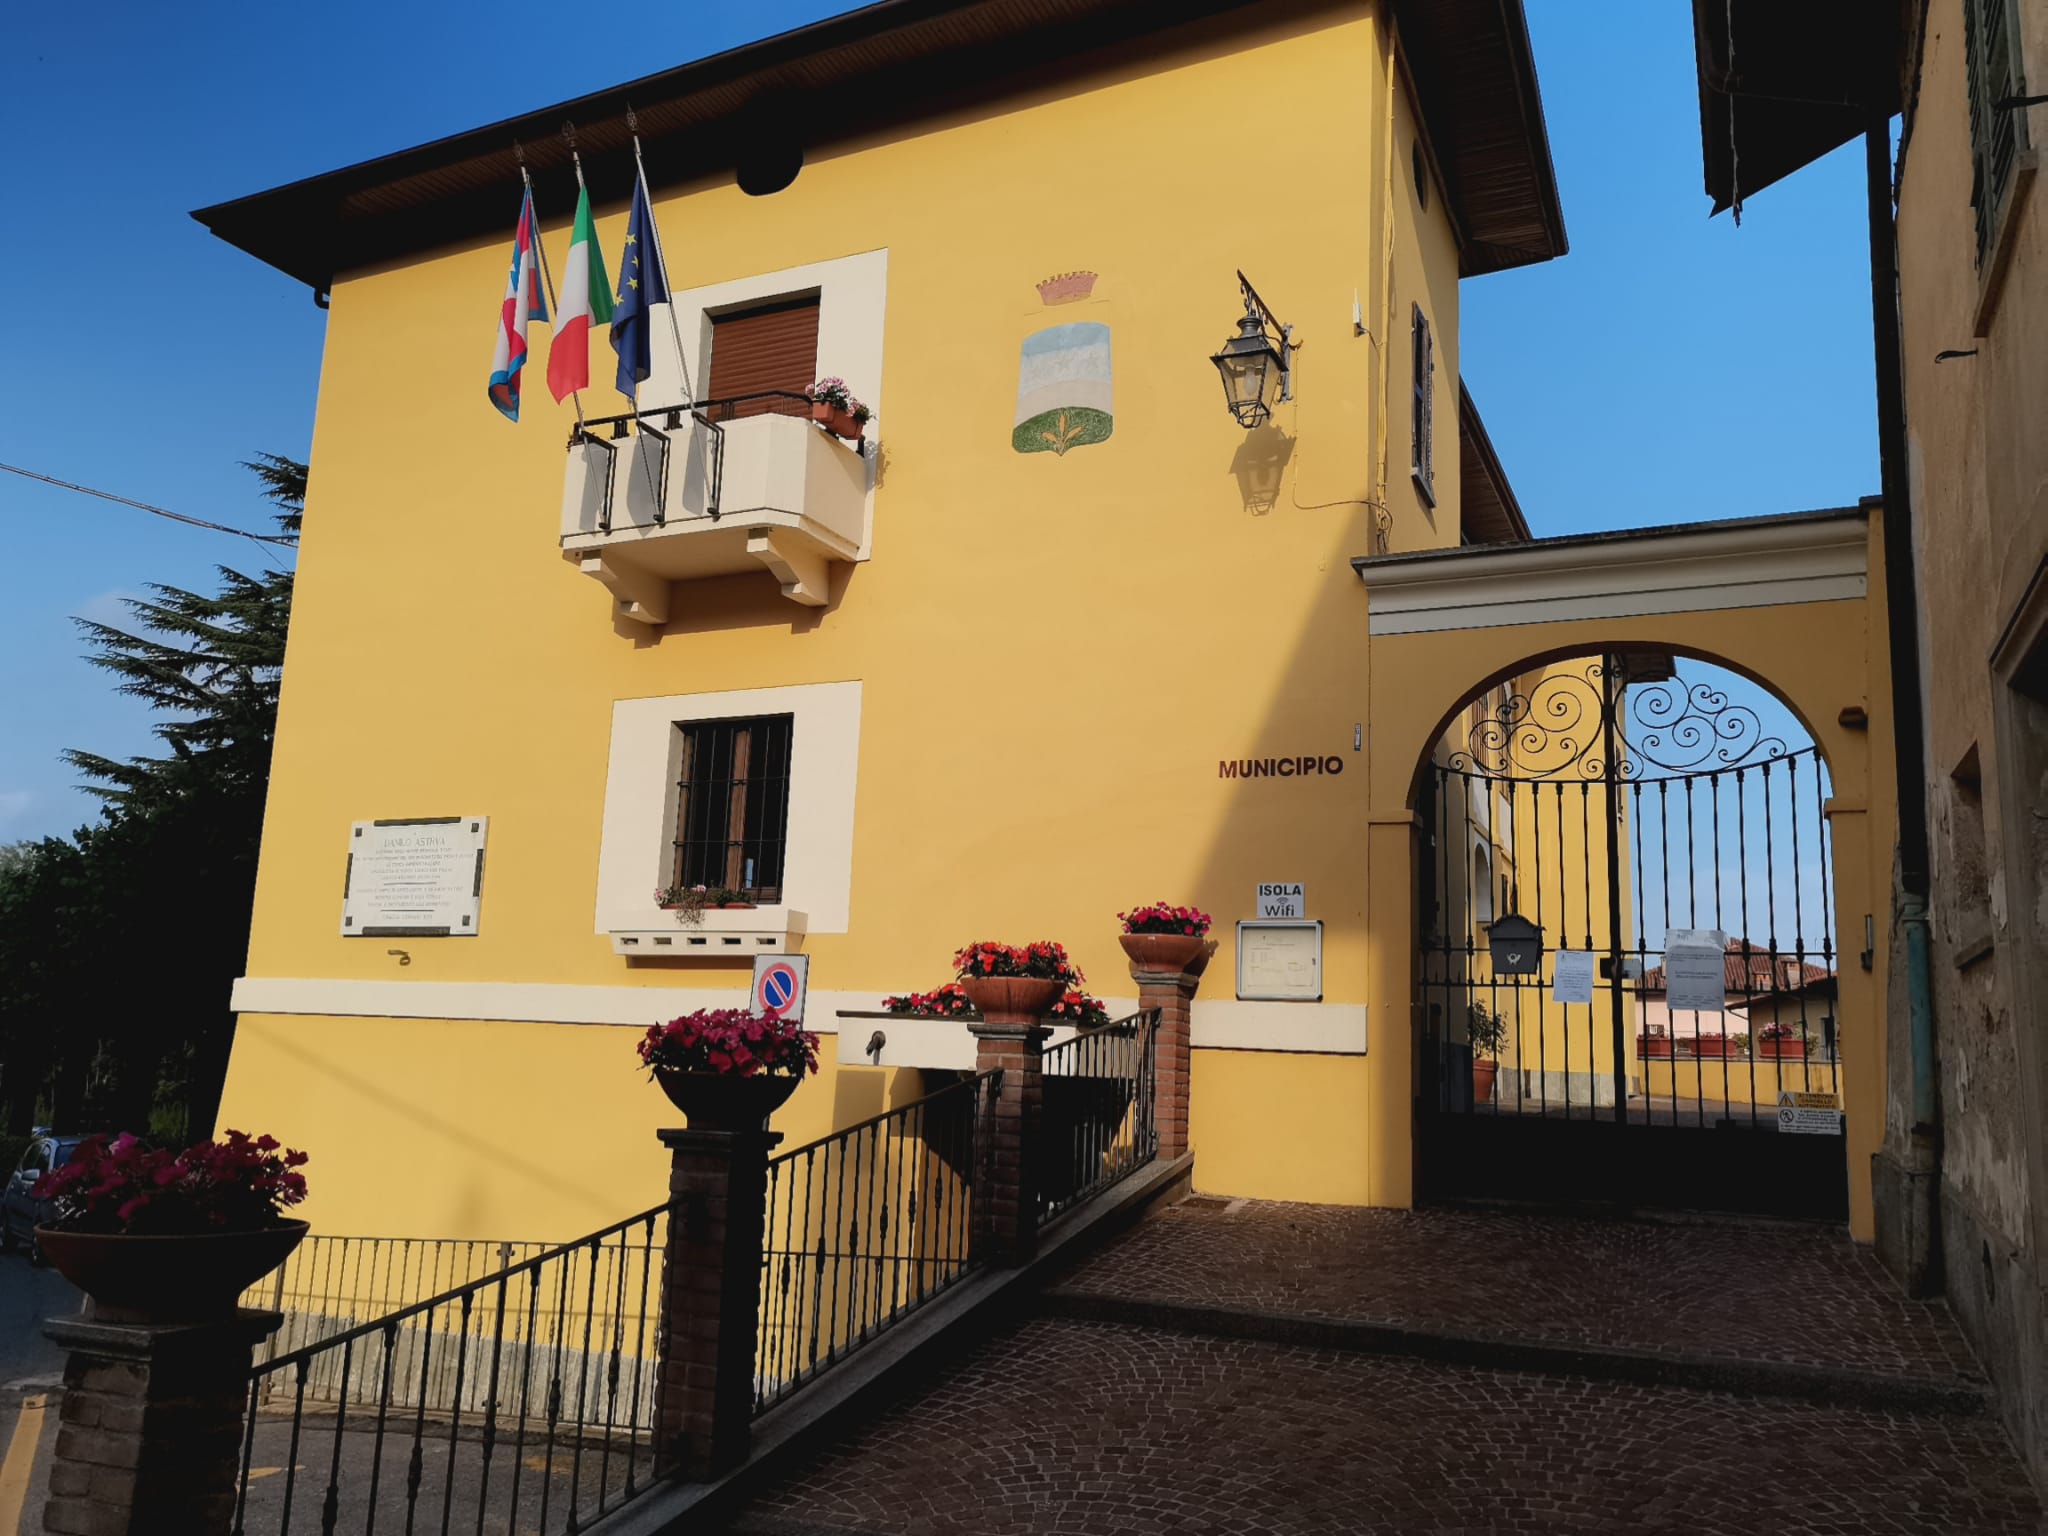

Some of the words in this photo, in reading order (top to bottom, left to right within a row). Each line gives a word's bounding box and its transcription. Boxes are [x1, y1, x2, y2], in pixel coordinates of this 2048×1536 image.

[1218, 755, 1344, 778] MUNICIPIO
[1259, 884, 1302, 897] ISOLA
[1264, 904, 1295, 917] Wifi
